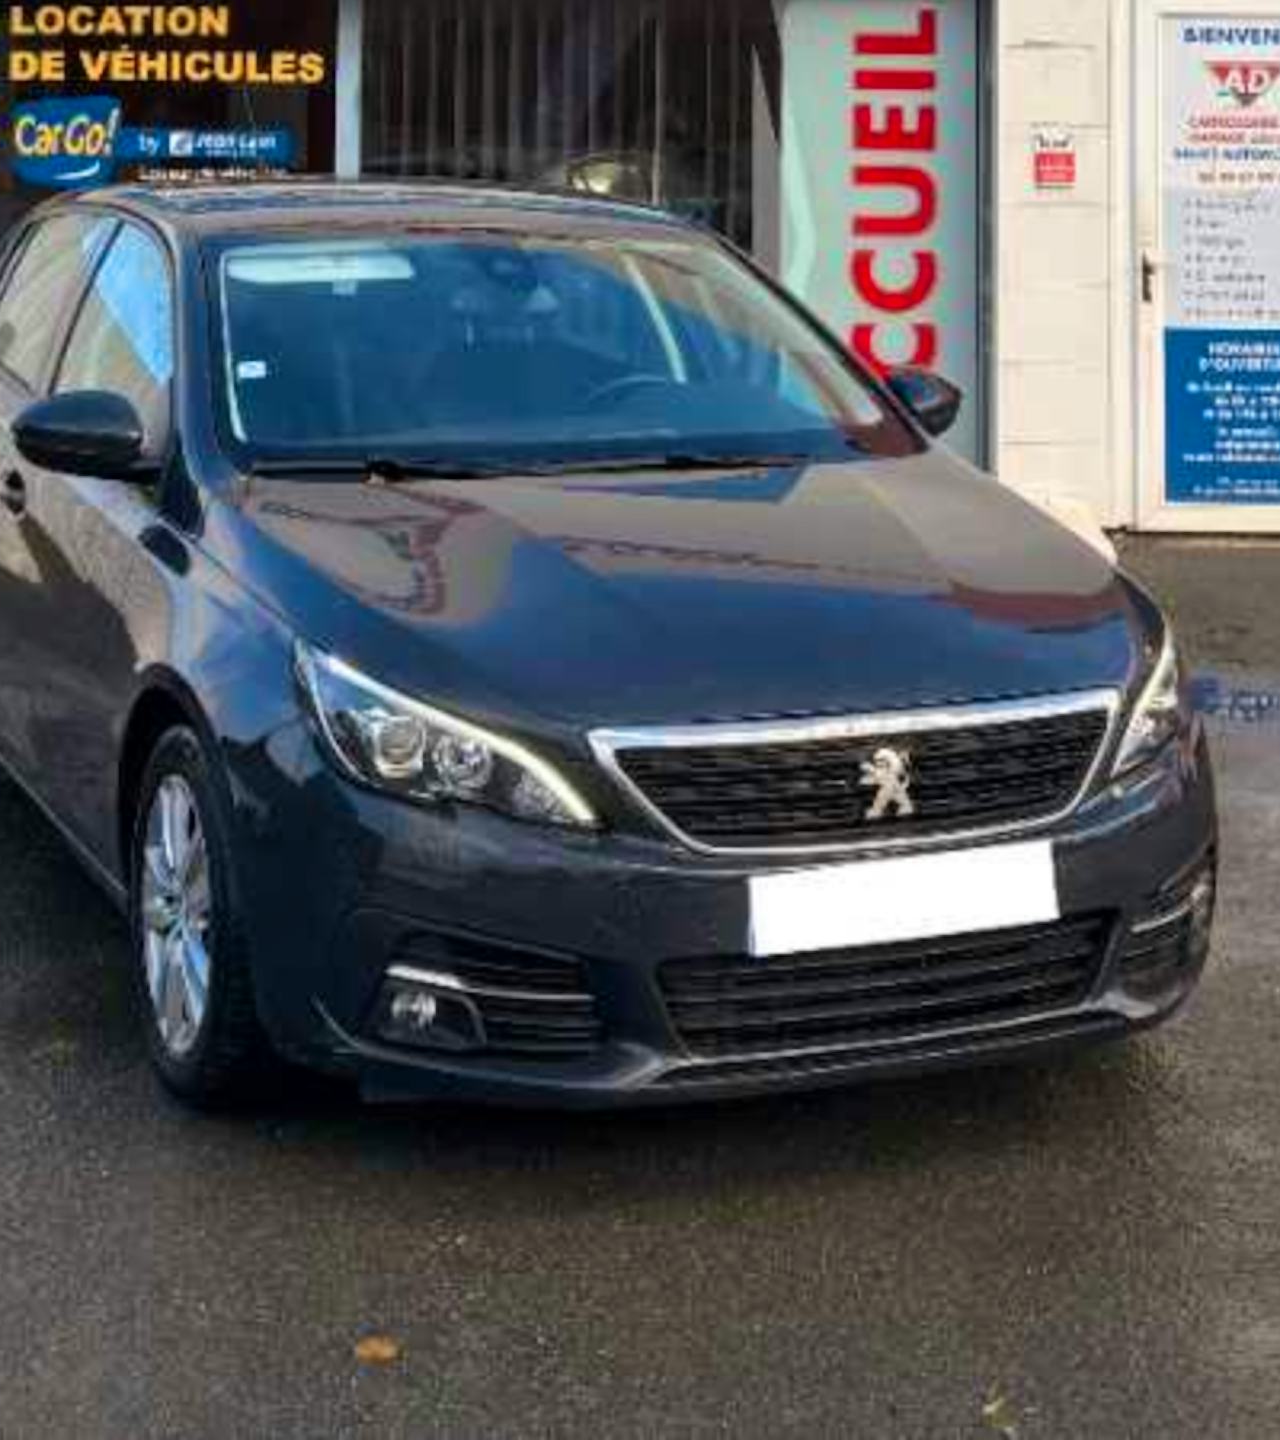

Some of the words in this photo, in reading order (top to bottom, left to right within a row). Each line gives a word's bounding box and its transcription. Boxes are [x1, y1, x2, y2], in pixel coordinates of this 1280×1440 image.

[9, 5, 229, 36] LOCATION
[9, 50, 66, 81] DE
[81, 45, 325, 84] VÉHICULES
[1225, 68, 1269, 92] AD
[851, 8, 938, 381] CCUEIL
